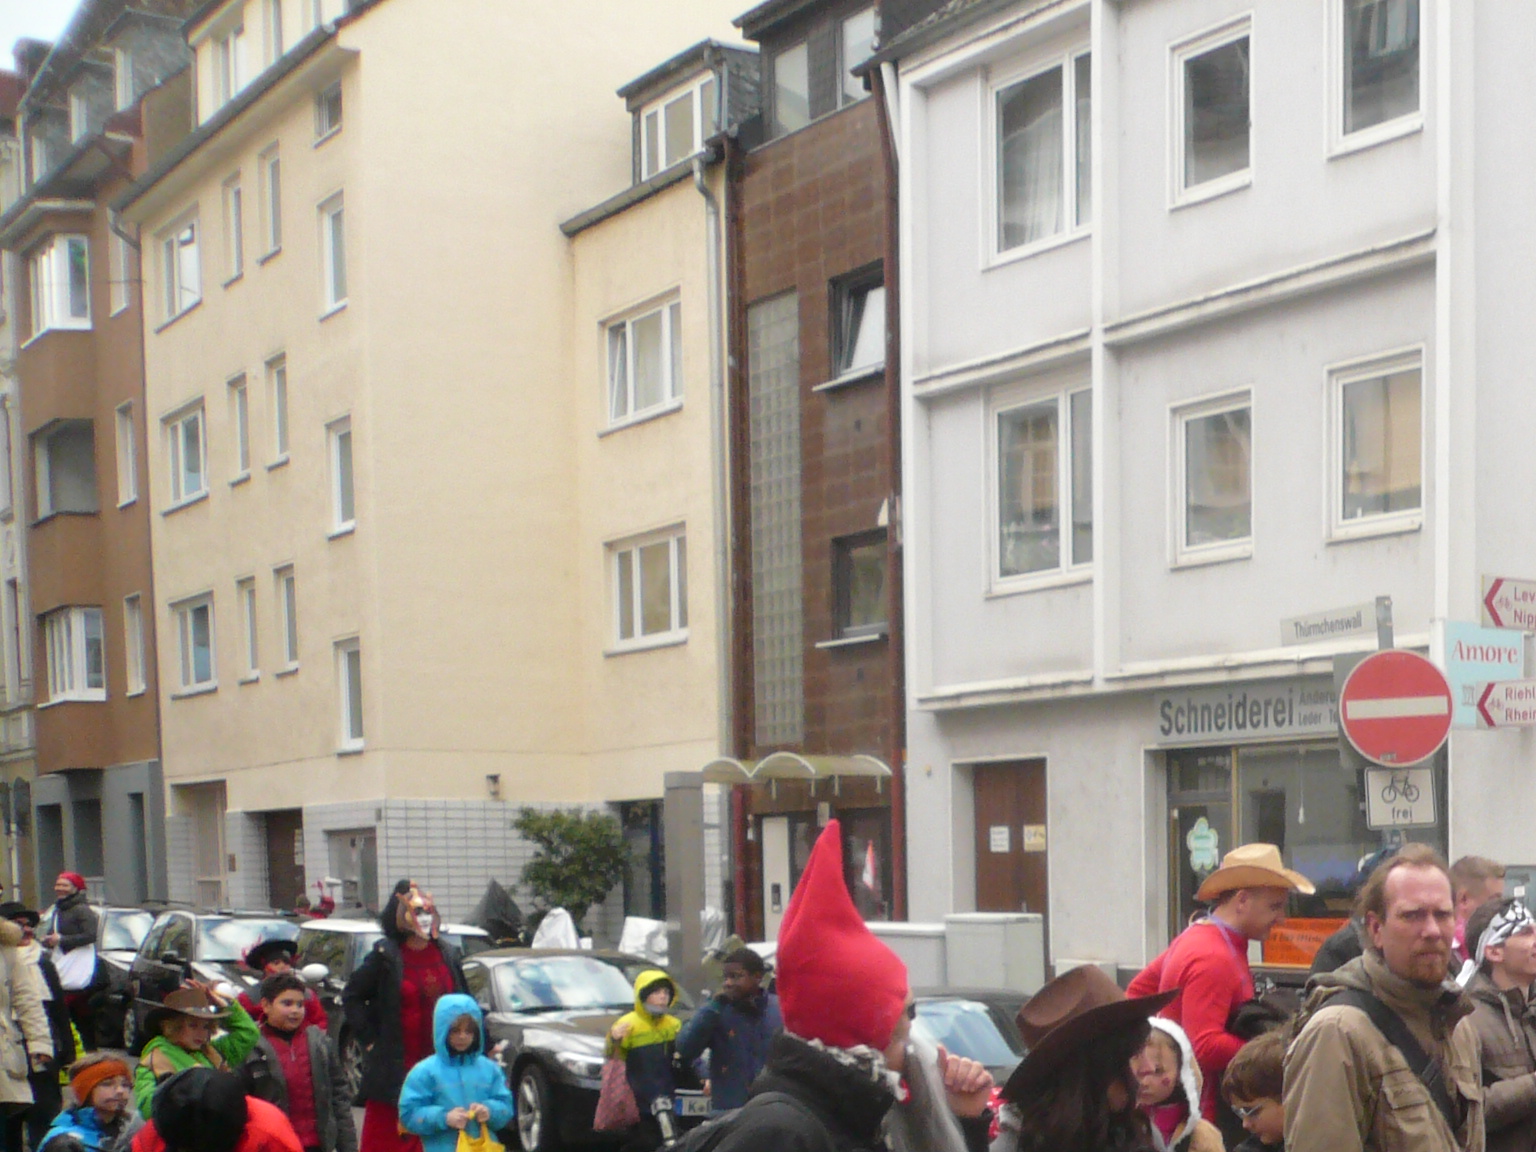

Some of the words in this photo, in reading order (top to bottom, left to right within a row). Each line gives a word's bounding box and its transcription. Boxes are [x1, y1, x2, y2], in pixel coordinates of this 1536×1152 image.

[1293, 610, 1363, 639] Thürmchenswall
[1451, 640, 1519, 664] Amore
[1159, 687, 1295, 737] Schneiderei
[1298, 712, 1322, 726] Leder
[1391, 806, 1413, 820] frei
